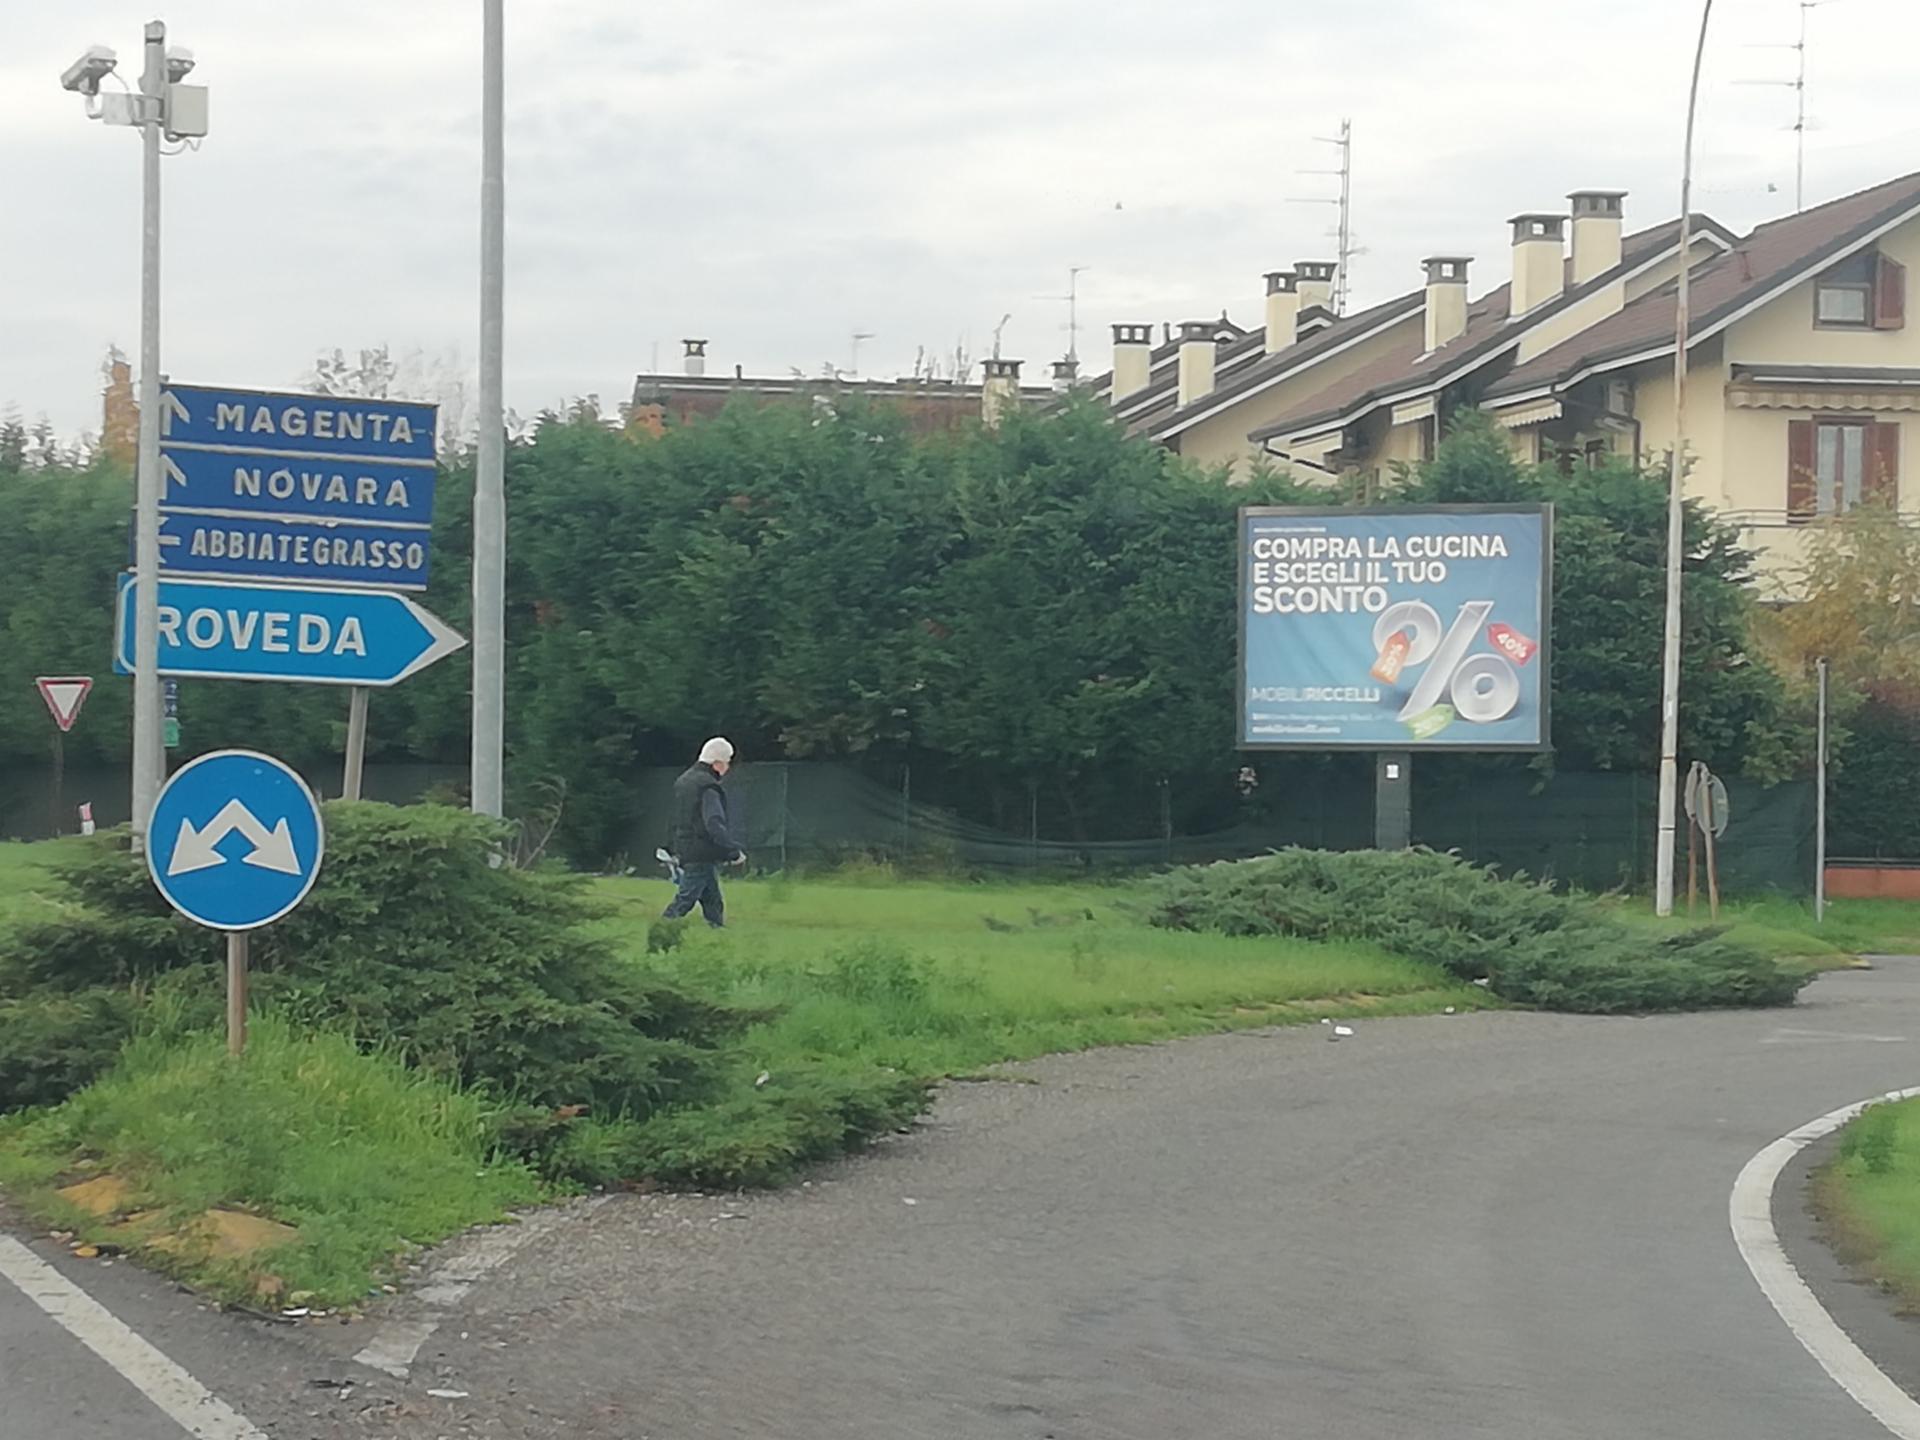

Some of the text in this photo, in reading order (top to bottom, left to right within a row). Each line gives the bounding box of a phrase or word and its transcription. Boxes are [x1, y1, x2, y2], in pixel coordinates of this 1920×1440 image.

[215, 402, 414, 444] MAGENTA
[233, 467, 410, 508] NOVARA
[190, 528, 424, 570] ABBIATEGRASSO
[1252, 535, 1508, 559] COMPRA LA CUCINA
[1252, 561, 1447, 584] E SCEGLI IL TUO
[1252, 586, 1388, 613] SCONTO
[158, 606, 367, 657] ROVEDA
[1496, 632, 1528, 659] 40%
